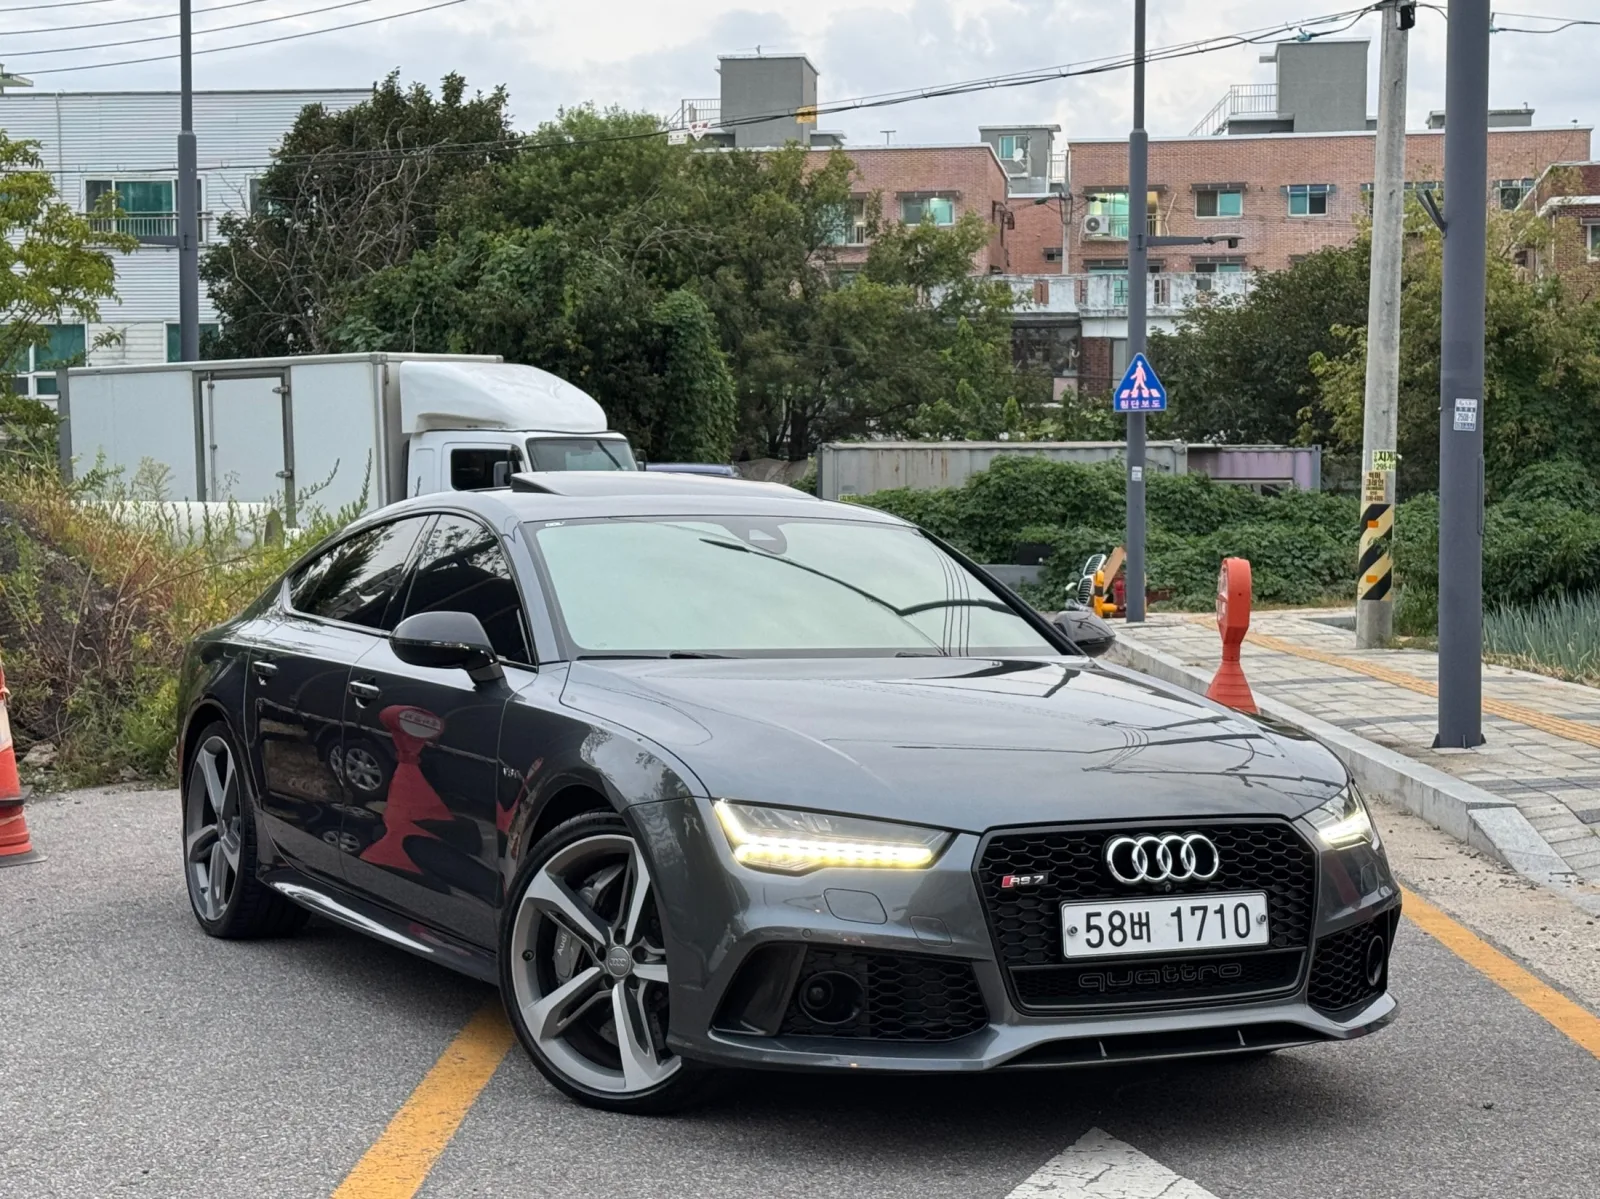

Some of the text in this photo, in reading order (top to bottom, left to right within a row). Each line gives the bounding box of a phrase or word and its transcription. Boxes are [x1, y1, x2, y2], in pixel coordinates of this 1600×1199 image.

[1085, 902, 1251, 949] 58버 1710
[557, 933, 568, 956] Audi
[1078, 962, 1242, 992] quattro
